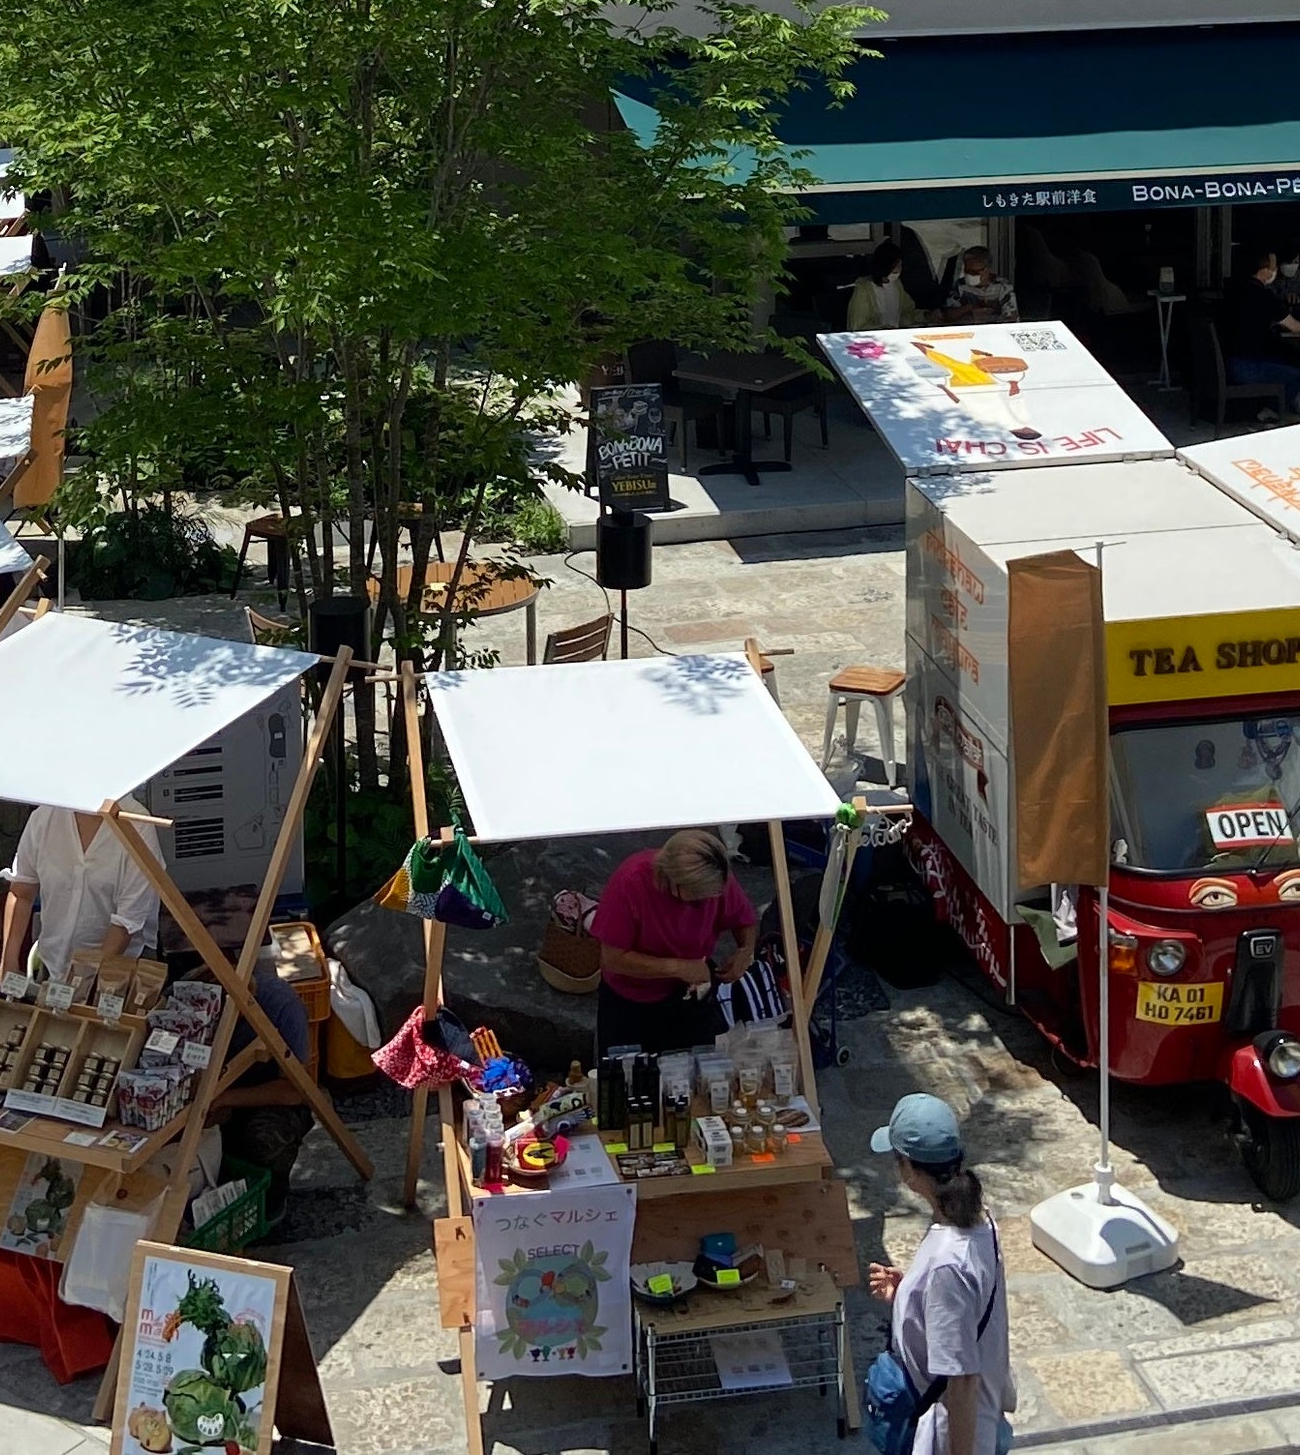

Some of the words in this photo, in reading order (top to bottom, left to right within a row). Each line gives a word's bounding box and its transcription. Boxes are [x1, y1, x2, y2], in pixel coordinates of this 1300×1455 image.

[982, 188, 1097, 208] しもきた駅前洋食
[936, 438, 1006, 455] CHAI
[1018, 441, 1049, 455] IS
[1052, 427, 1123, 450] LIFE
[611, 479, 651, 492] YEBISU
[1130, 644, 1204, 677] TEA
[973, 803, 997, 844] TASTE
[1217, 811, 1284, 839] OPEN
[1255, 943, 1273, 955] EV
[1157, 984, 1182, 1003] KA
[1187, 988, 1205, 1003] 01
[1174, 1004, 1215, 1022] 7461
[495, 1207, 619, 1233] つなぐマルシェ
[527, 1243, 580, 1260] SELECT
